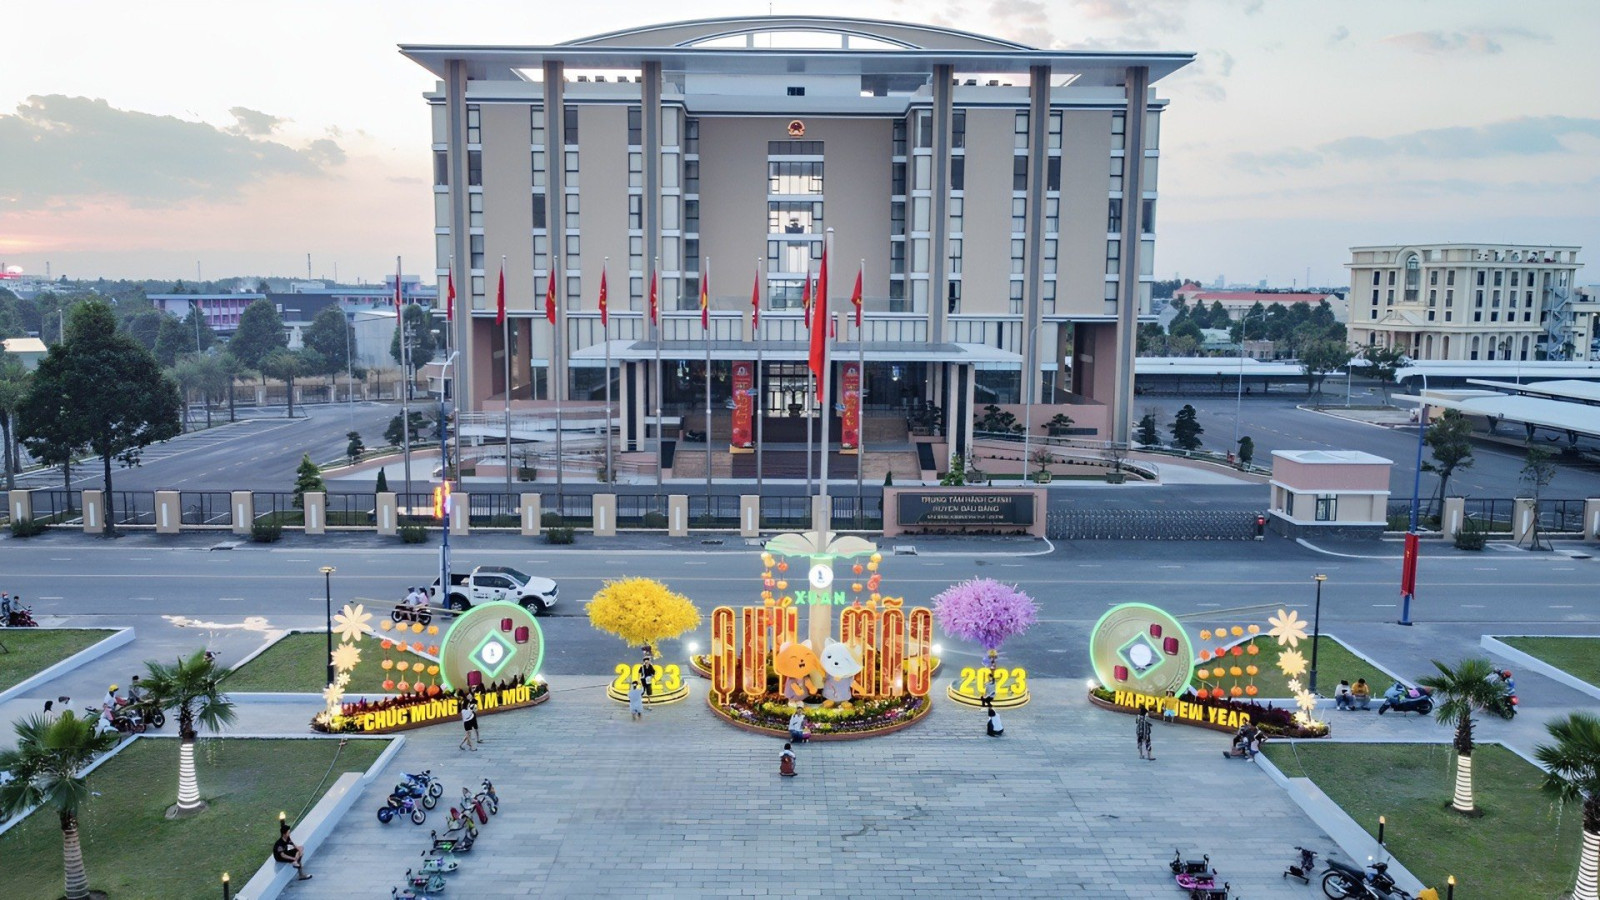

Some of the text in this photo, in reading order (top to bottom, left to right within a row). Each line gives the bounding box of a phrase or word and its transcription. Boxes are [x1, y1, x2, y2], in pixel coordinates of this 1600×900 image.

[363, 707, 408, 731] CHÚC
[460, 691, 498, 712] ĂM
[1115, 690, 1164, 713] HAPPY
[1208, 706, 1250, 729] YEAR
